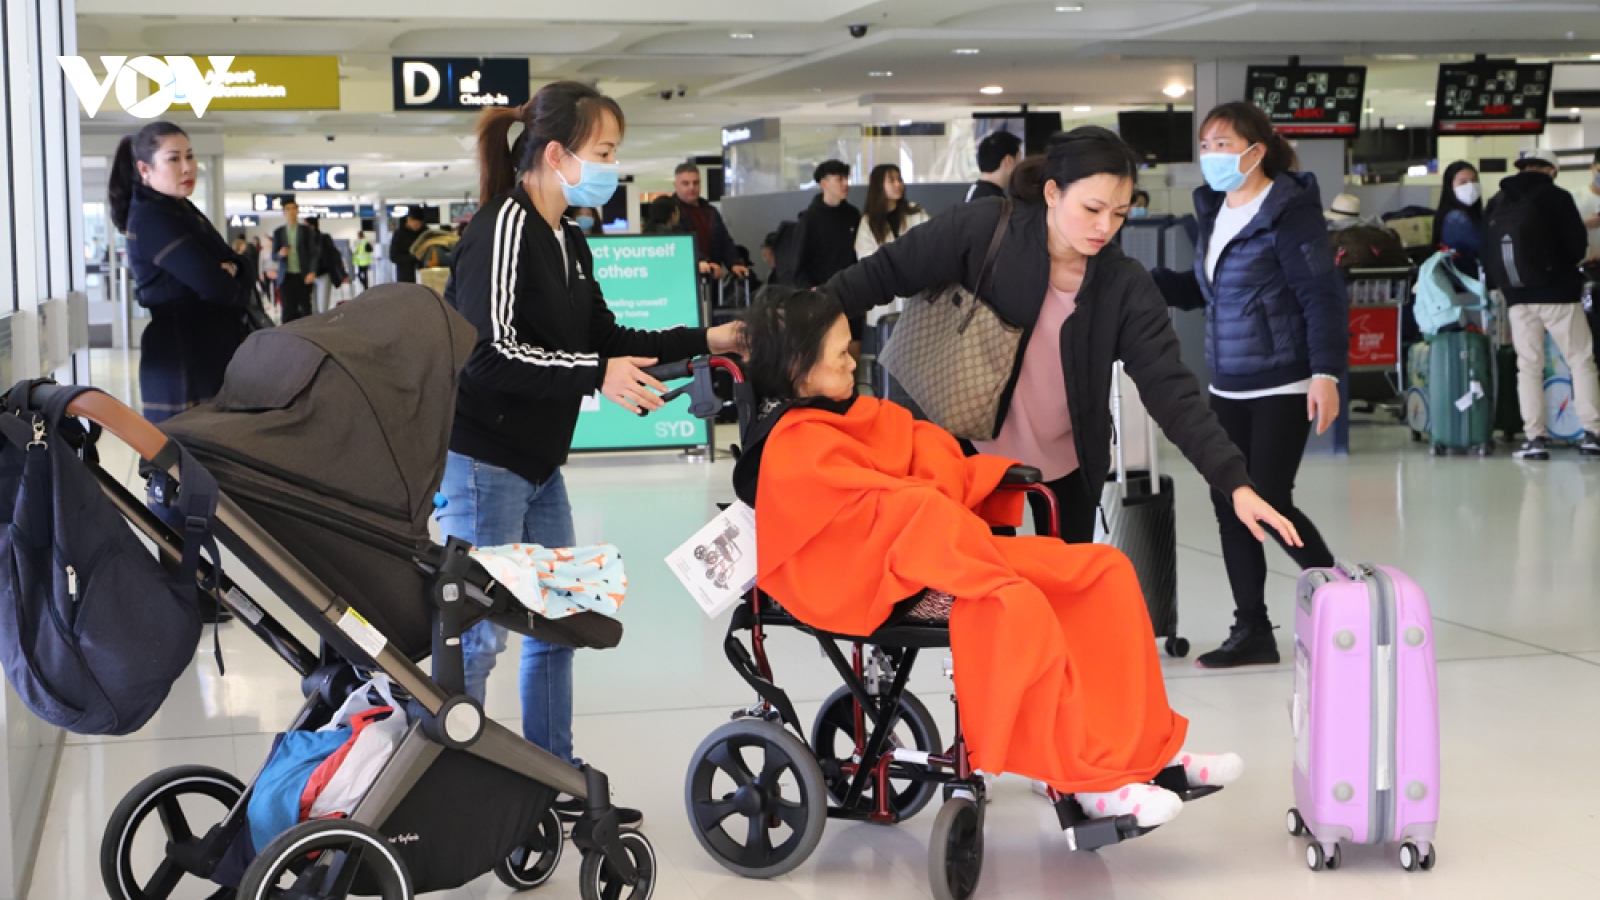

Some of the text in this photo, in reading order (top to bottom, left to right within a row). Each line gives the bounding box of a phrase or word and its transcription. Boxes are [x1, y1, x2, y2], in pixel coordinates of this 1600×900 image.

[205, 69, 256, 85] Aport
[402, 61, 440, 105] D
[208, 82, 287, 98] formation
[460, 93, 509, 106] Check-in
[326, 166, 346, 189] C
[612, 242, 675, 260] yourself
[598, 265, 649, 278] others
[654, 420, 695, 438] SYD
